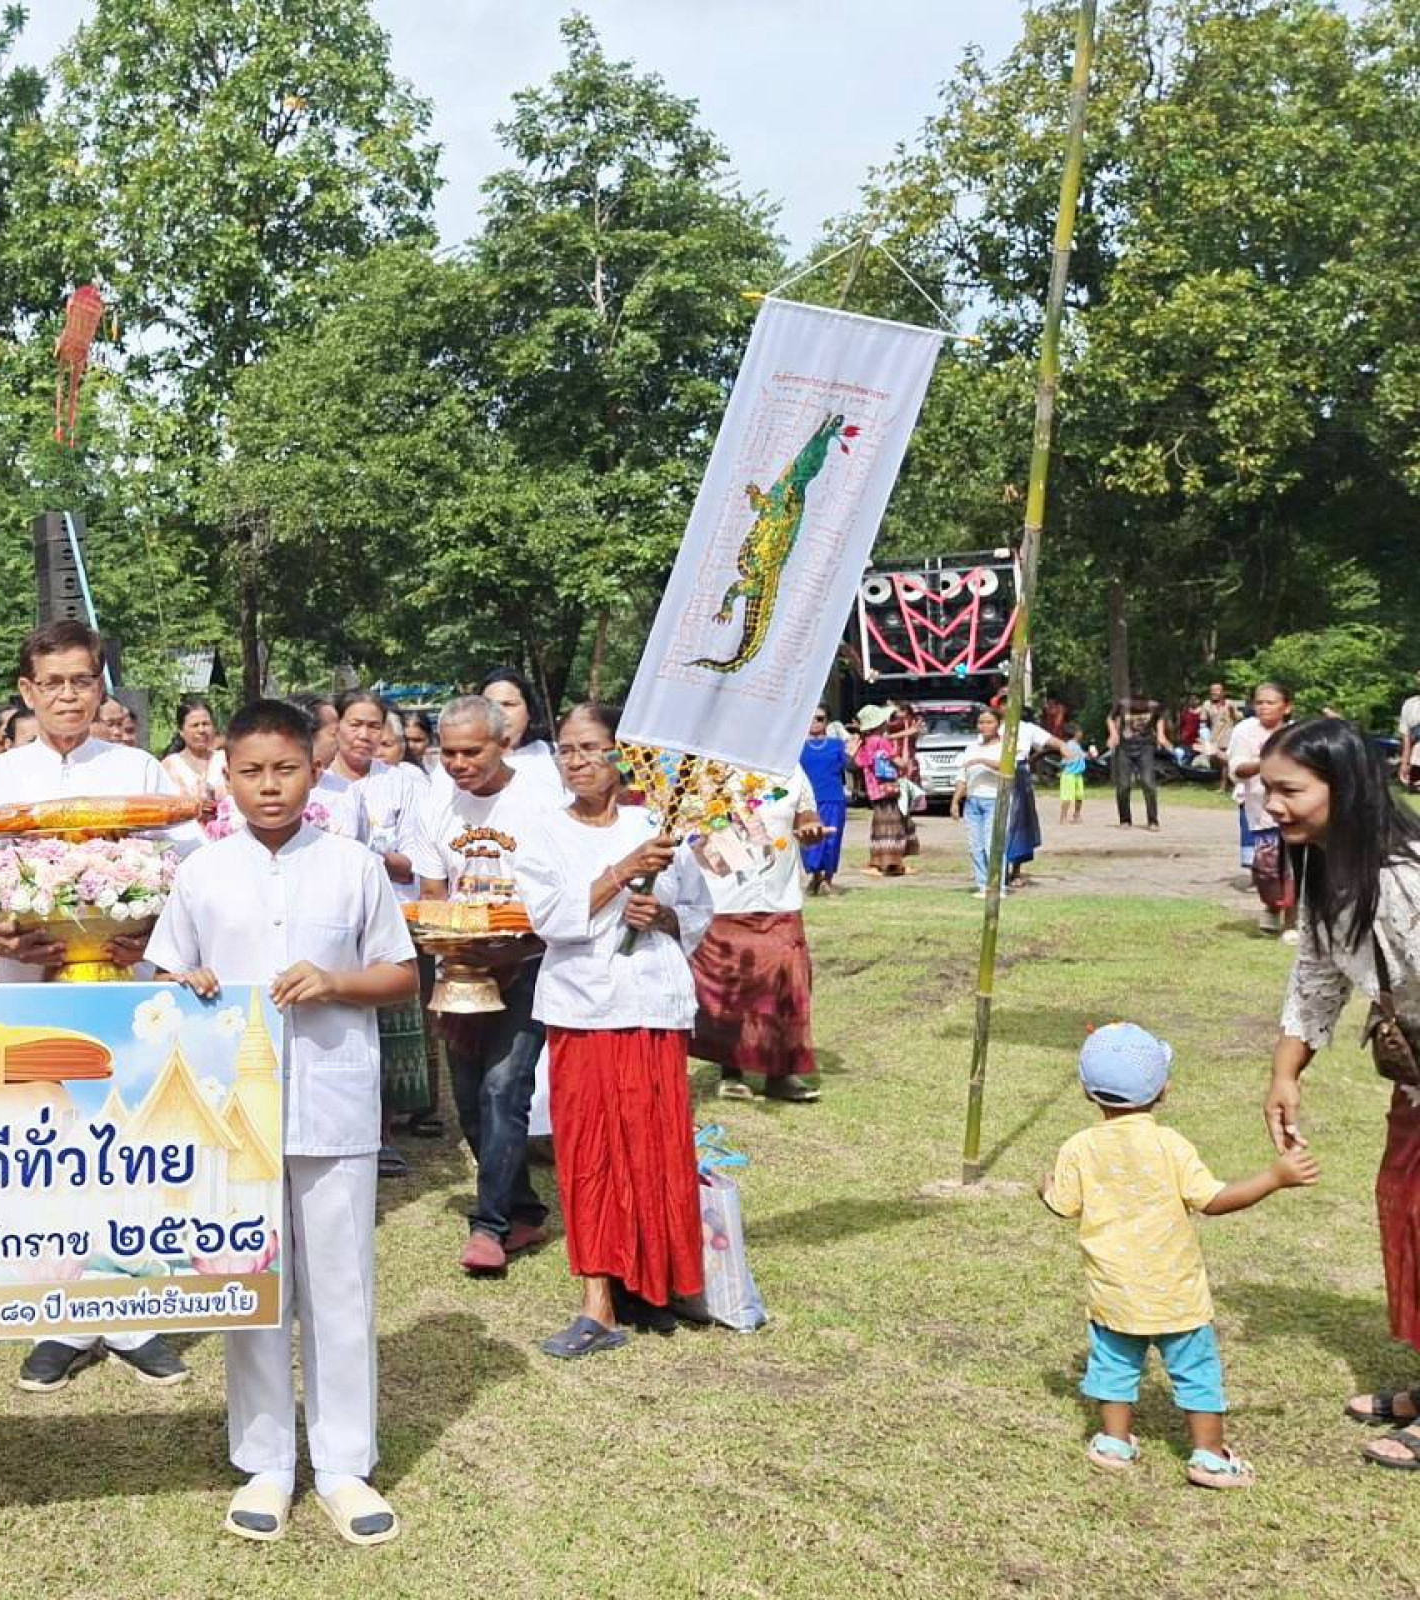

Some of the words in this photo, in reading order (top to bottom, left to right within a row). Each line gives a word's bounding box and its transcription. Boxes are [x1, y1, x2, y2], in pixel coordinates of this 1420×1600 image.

[108, 1214, 266, 1256] ๒๕๖๘
[0, 1303, 36, 1322] ๘๑
[44, 1293, 61, 1320] ปี
